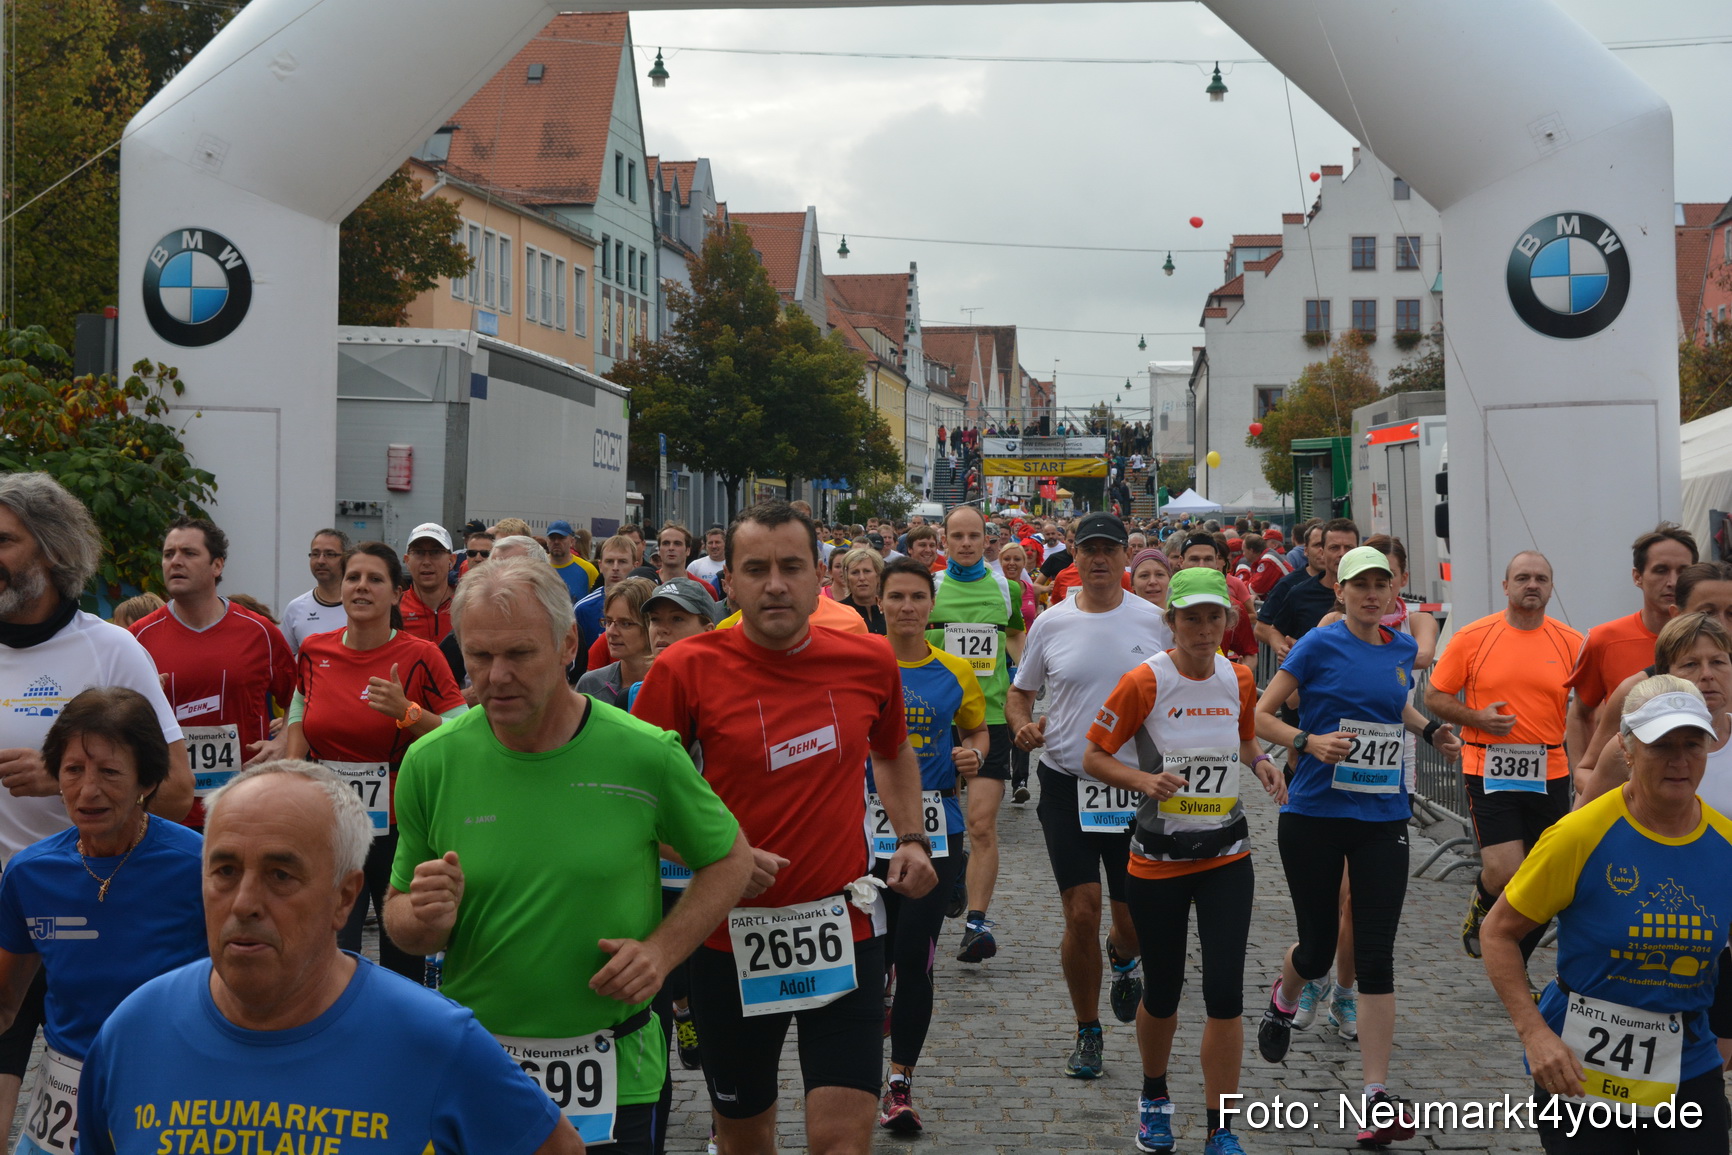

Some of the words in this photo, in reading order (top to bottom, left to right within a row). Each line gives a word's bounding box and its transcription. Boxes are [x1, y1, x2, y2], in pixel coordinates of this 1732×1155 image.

[1517, 215, 1621, 258] BMW
[151, 230, 243, 270] BMW
[593, 428, 622, 472] BOCK
[1023, 461, 1066, 472] START
[957, 635, 992, 656] 124
[187, 702, 208, 713] DEHN
[1186, 707, 1233, 716] KLEBL
[188, 732, 226, 740] Neumarkt
[1340, 725, 1367, 736] PARTL
[187, 742, 234, 770] 194
[788, 737, 818, 757] DEHN
[1345, 738, 1400, 766] 2412
[1487, 746, 1507, 754] PARTL
[1194, 755, 1229, 763] Neumarkt
[1490, 755, 1540, 778] 3381
[197, 778, 212, 787] we
[337, 769, 374, 777] Neumarkt
[1179, 765, 1228, 793] 127
[1085, 785, 1139, 809] 2109
[1179, 800, 1221, 814] Sylvana
[475, 815, 497, 824] JAKO
[1613, 876, 1633, 884] Jahre
[731, 916, 768, 928] PARTL
[771, 908, 828, 924] Neumarkt
[744, 922, 842, 972] 2656
[1691, 945, 1711, 953] 2014
[779, 976, 816, 996] Adolf
[1570, 1003, 1608, 1022] PARTL
[1610, 1014, 1666, 1031] Neumarkt
[522, 1044, 590, 1059] Neumarkt
[1584, 1026, 1657, 1075] 241
[49, 1074, 79, 1096] Neuma
[1602, 1078, 1629, 1099] Eva
[134, 1103, 162, 1130] 10.
[169, 1099, 390, 1140] NEUMARKTER
[157, 1128, 342, 1155] STADTLAUF
